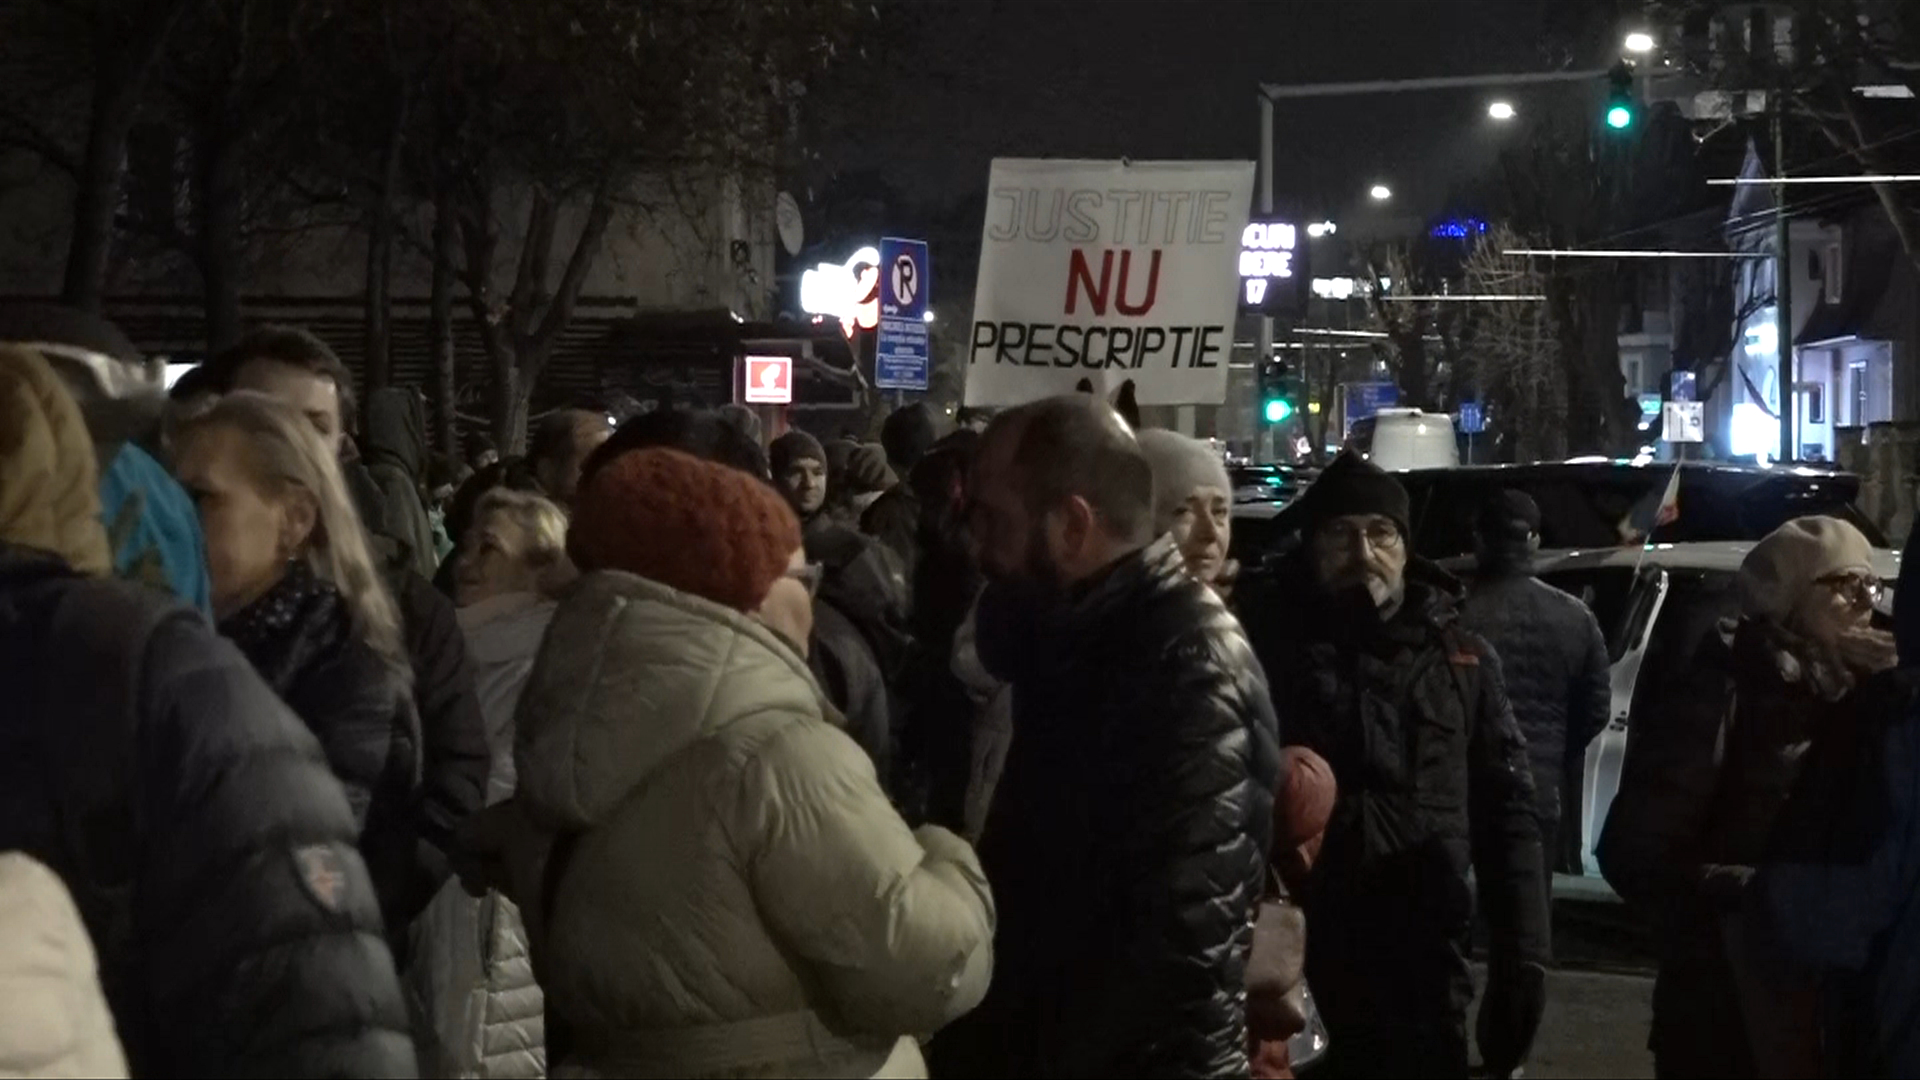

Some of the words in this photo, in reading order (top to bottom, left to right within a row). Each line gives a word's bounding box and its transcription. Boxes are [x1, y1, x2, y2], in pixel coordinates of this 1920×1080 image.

[988, 187, 1232, 245] JUSTITIE
[1064, 249, 1162, 317] NU
[1246, 278, 1268, 304] 17
[970, 321, 1224, 369] PRESCRIPTIE
